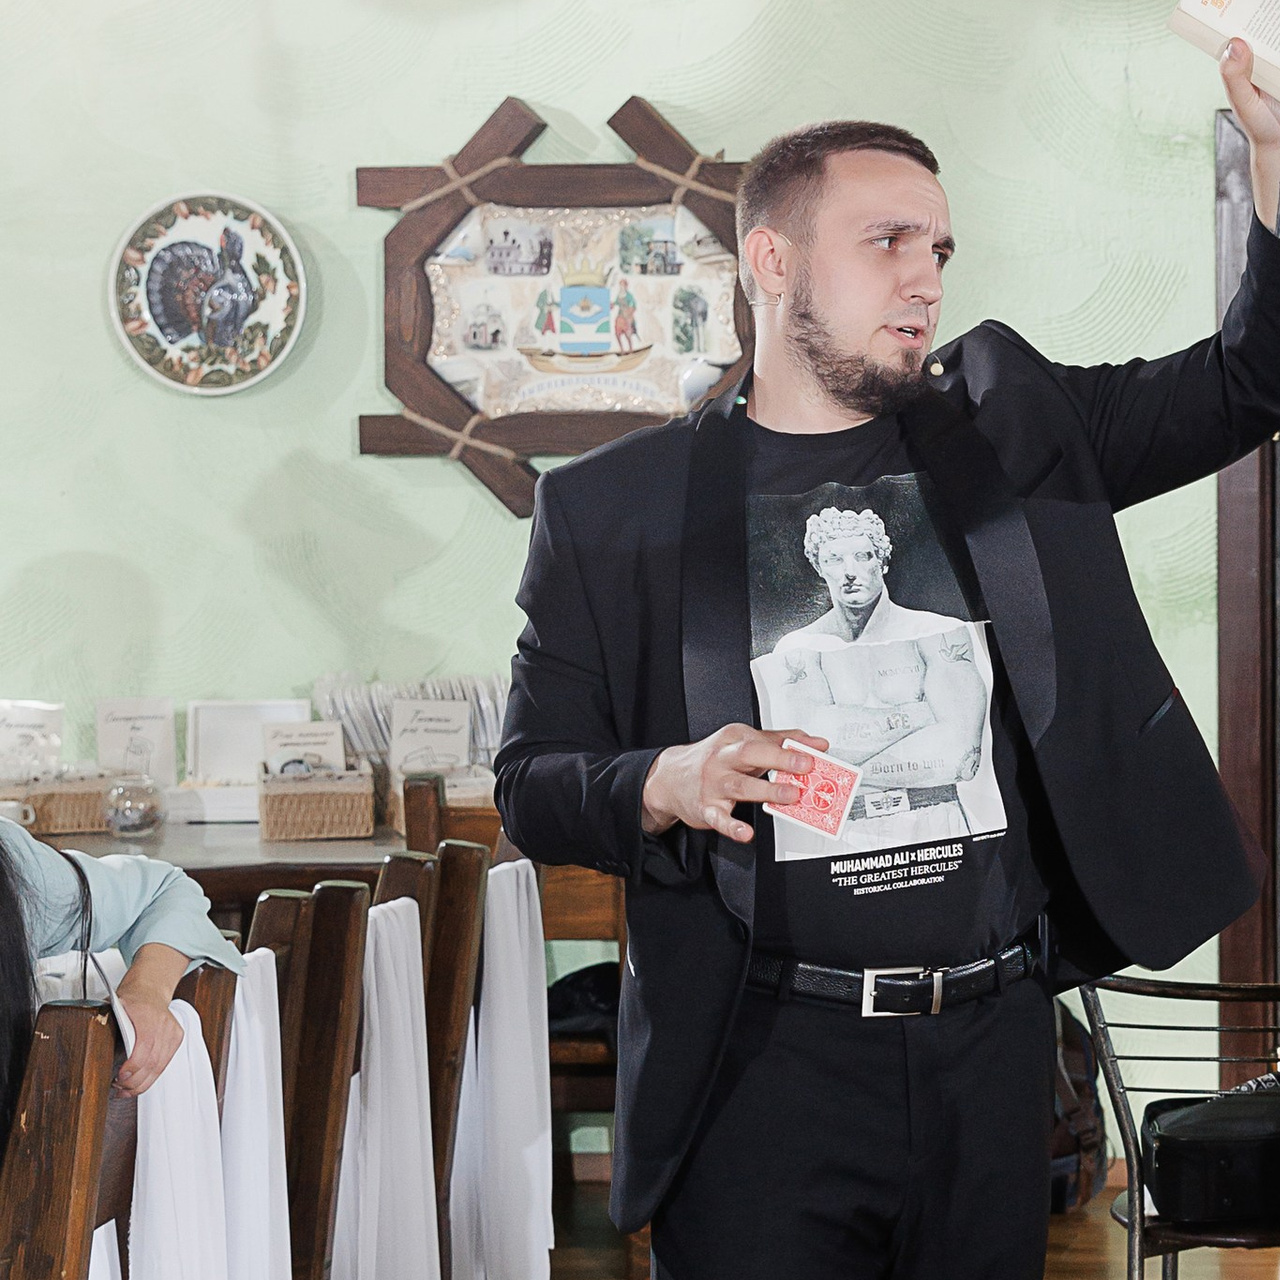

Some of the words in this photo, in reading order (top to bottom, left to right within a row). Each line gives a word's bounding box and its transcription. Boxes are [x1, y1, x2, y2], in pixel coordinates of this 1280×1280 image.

[871, 761, 904, 775] Born
[907, 761, 919, 772] to
[830, 854, 893, 875] MUHAMMAD
[893, 850, 910, 866] ALI
[917, 843, 964, 862] HERCULES
[859, 867, 909, 884] GREATEST
[853, 884, 893, 896] HISTORICAL
[892, 875, 945, 890] COLLABORATION
